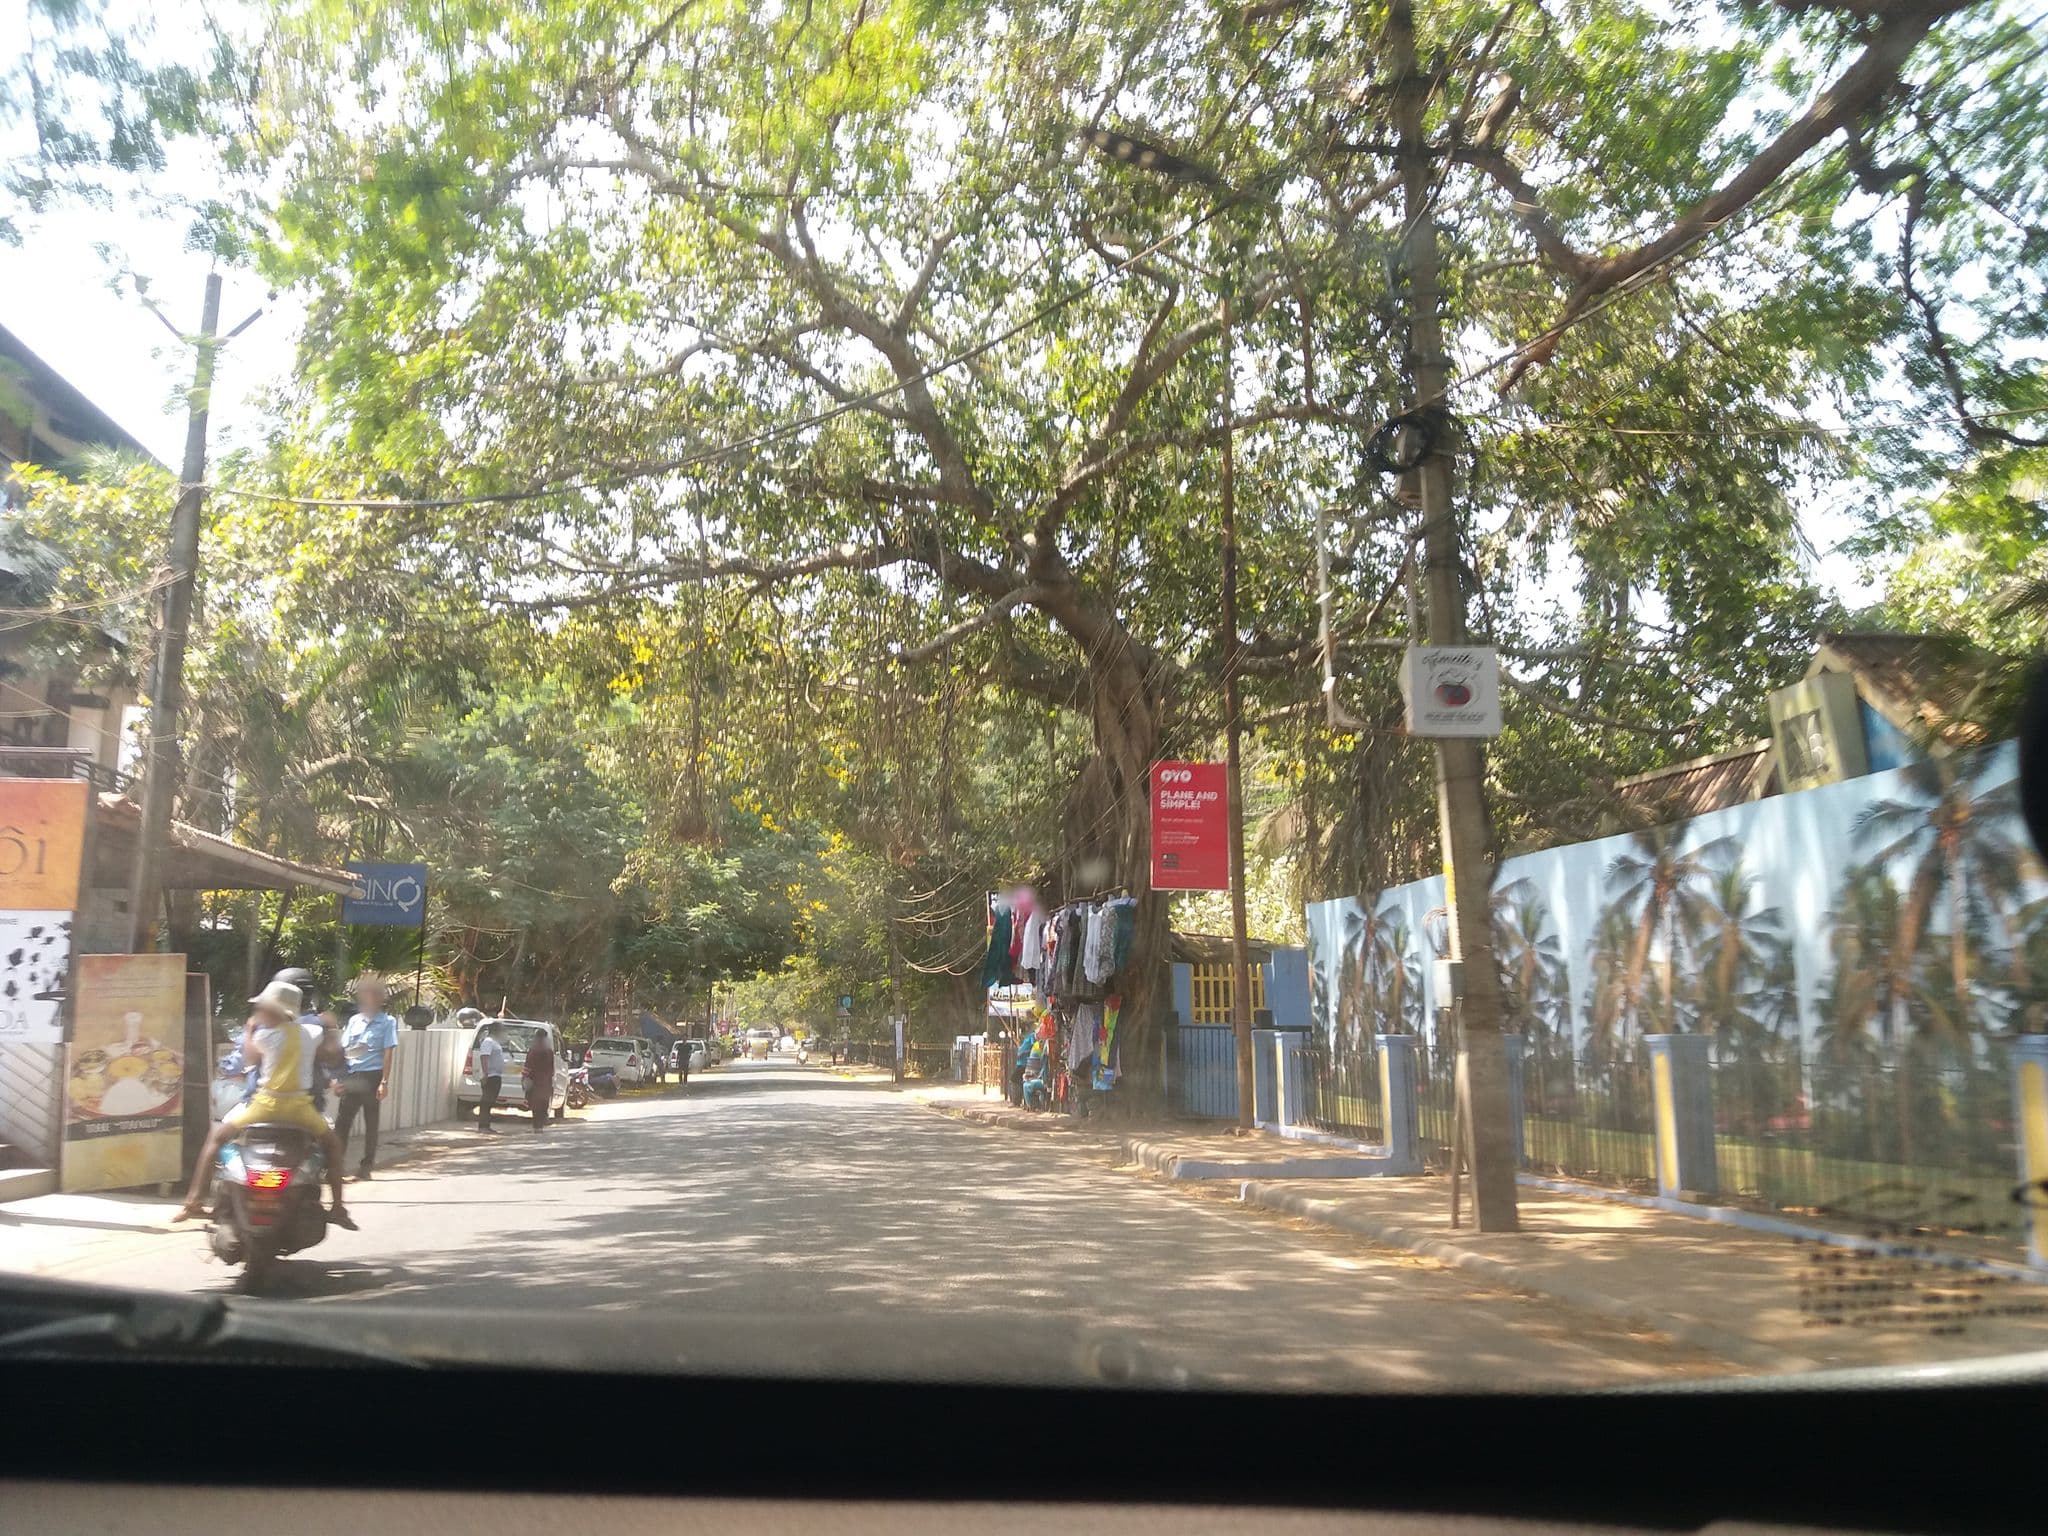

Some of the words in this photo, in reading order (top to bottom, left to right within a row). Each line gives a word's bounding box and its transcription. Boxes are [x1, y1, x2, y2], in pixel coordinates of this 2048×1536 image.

[1160, 769, 1192, 784] OYO
[1160, 790, 1195, 801] PLANE
[1196, 791, 1219, 802] AND
